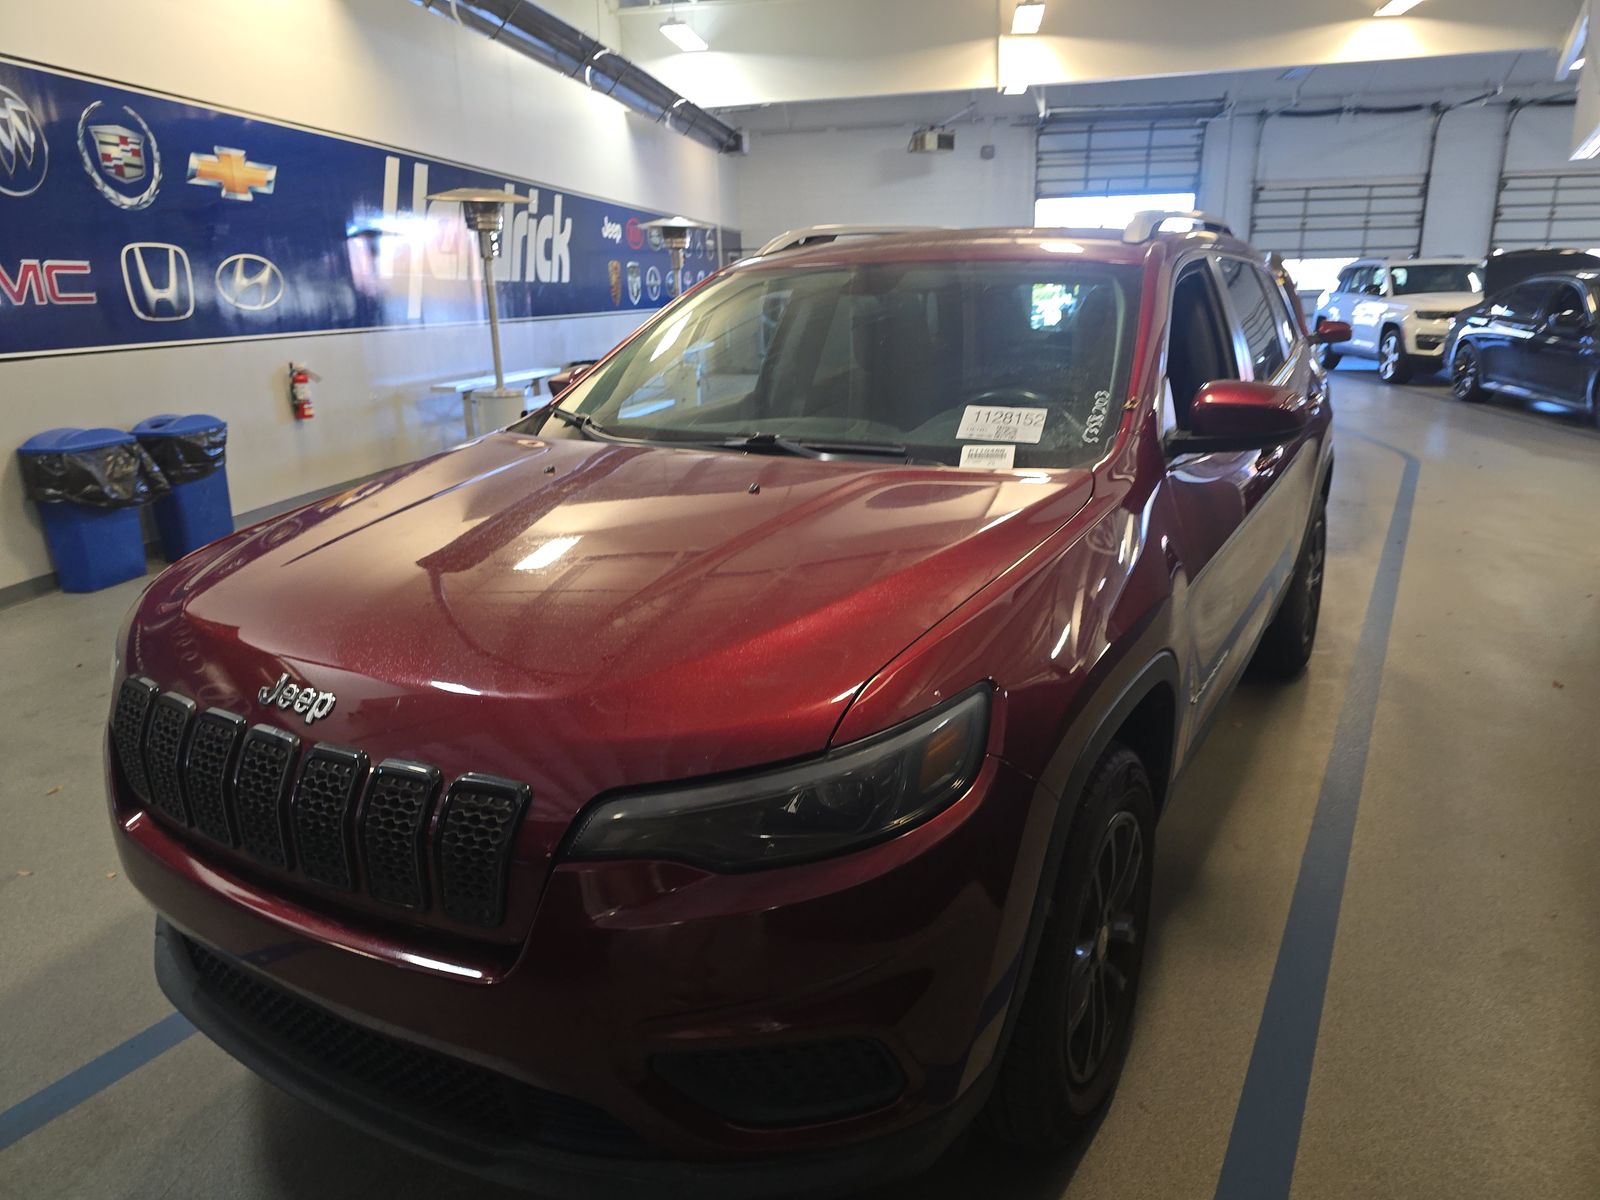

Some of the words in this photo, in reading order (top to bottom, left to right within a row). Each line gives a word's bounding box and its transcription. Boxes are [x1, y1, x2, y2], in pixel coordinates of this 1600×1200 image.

[0, 259, 97, 305] MC
[974, 410, 1045, 427] 1128152
[257, 672, 337, 724] Jeep
